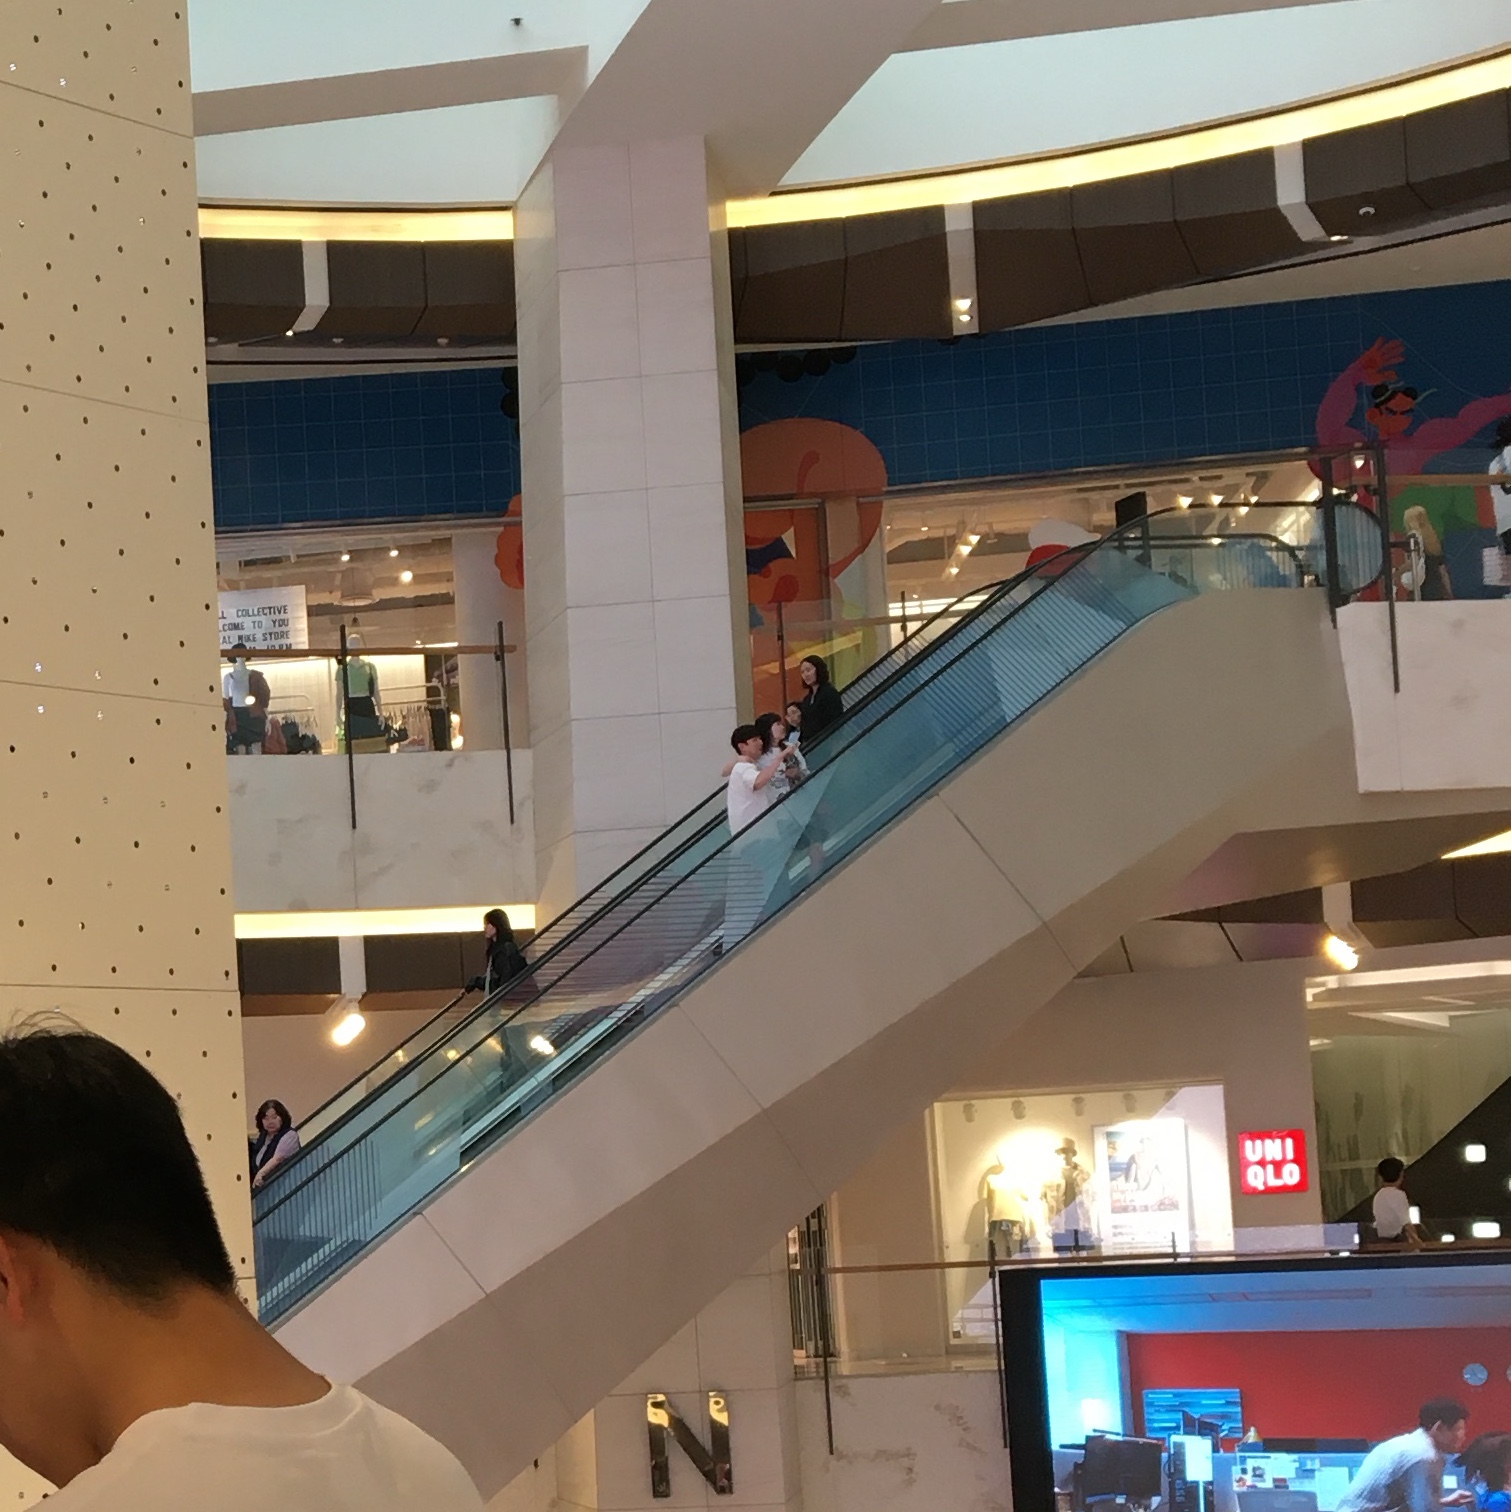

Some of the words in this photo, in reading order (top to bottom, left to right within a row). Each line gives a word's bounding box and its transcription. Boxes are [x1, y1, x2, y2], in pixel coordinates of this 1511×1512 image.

[236, 605, 288, 618] COLLECTIVE
[219, 620, 245, 632] COME
[251, 620, 263, 630] TO
[271, 618, 290, 628] YOU
[262, 630, 290, 642] STORE
[1245, 1137, 1294, 1162] UNI
[1246, 1162, 1300, 1191] QLO
[646, 1391, 734, 1498] N
